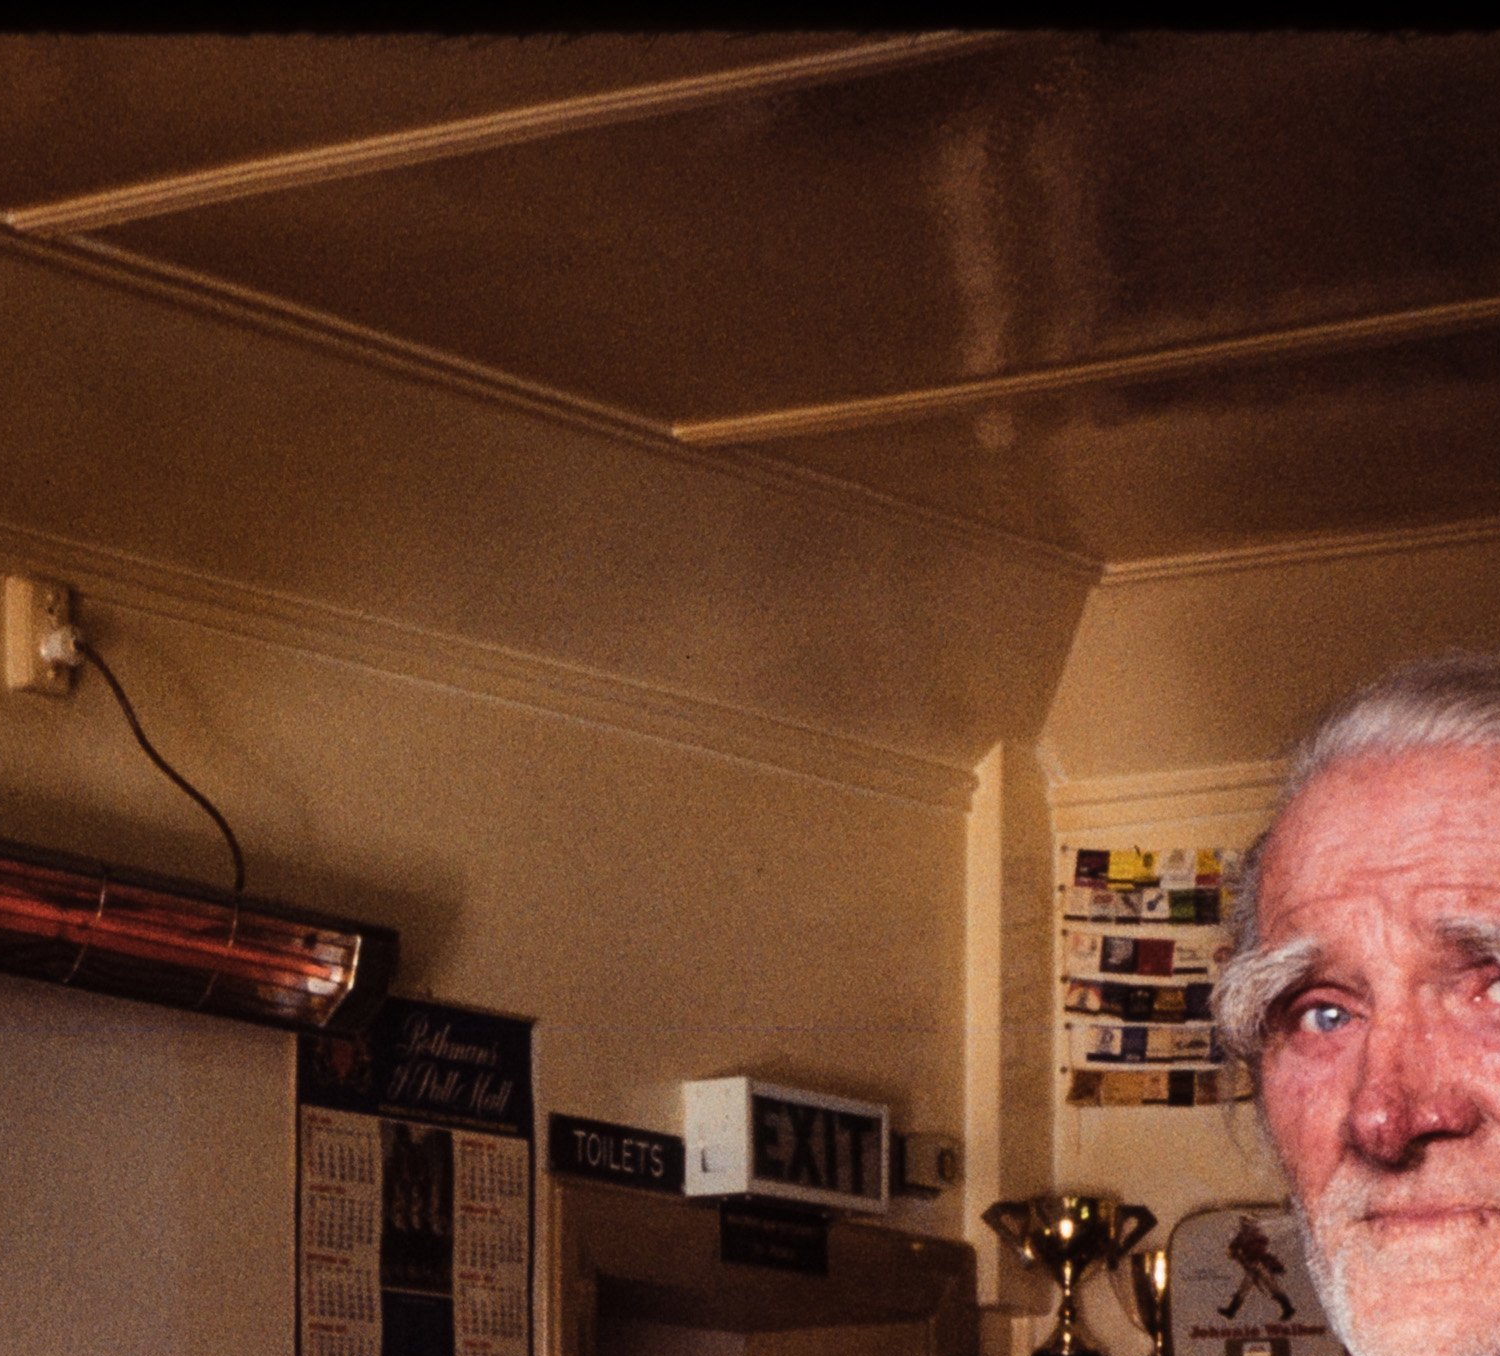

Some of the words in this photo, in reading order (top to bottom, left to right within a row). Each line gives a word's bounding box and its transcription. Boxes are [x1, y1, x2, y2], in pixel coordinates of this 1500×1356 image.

[573, 1129, 665, 1178] TOILETS
[762, 1106, 874, 1196] EXIT
[1189, 1324, 1260, 1339] Johnnie
[1264, 1323, 1327, 1337] Walker
